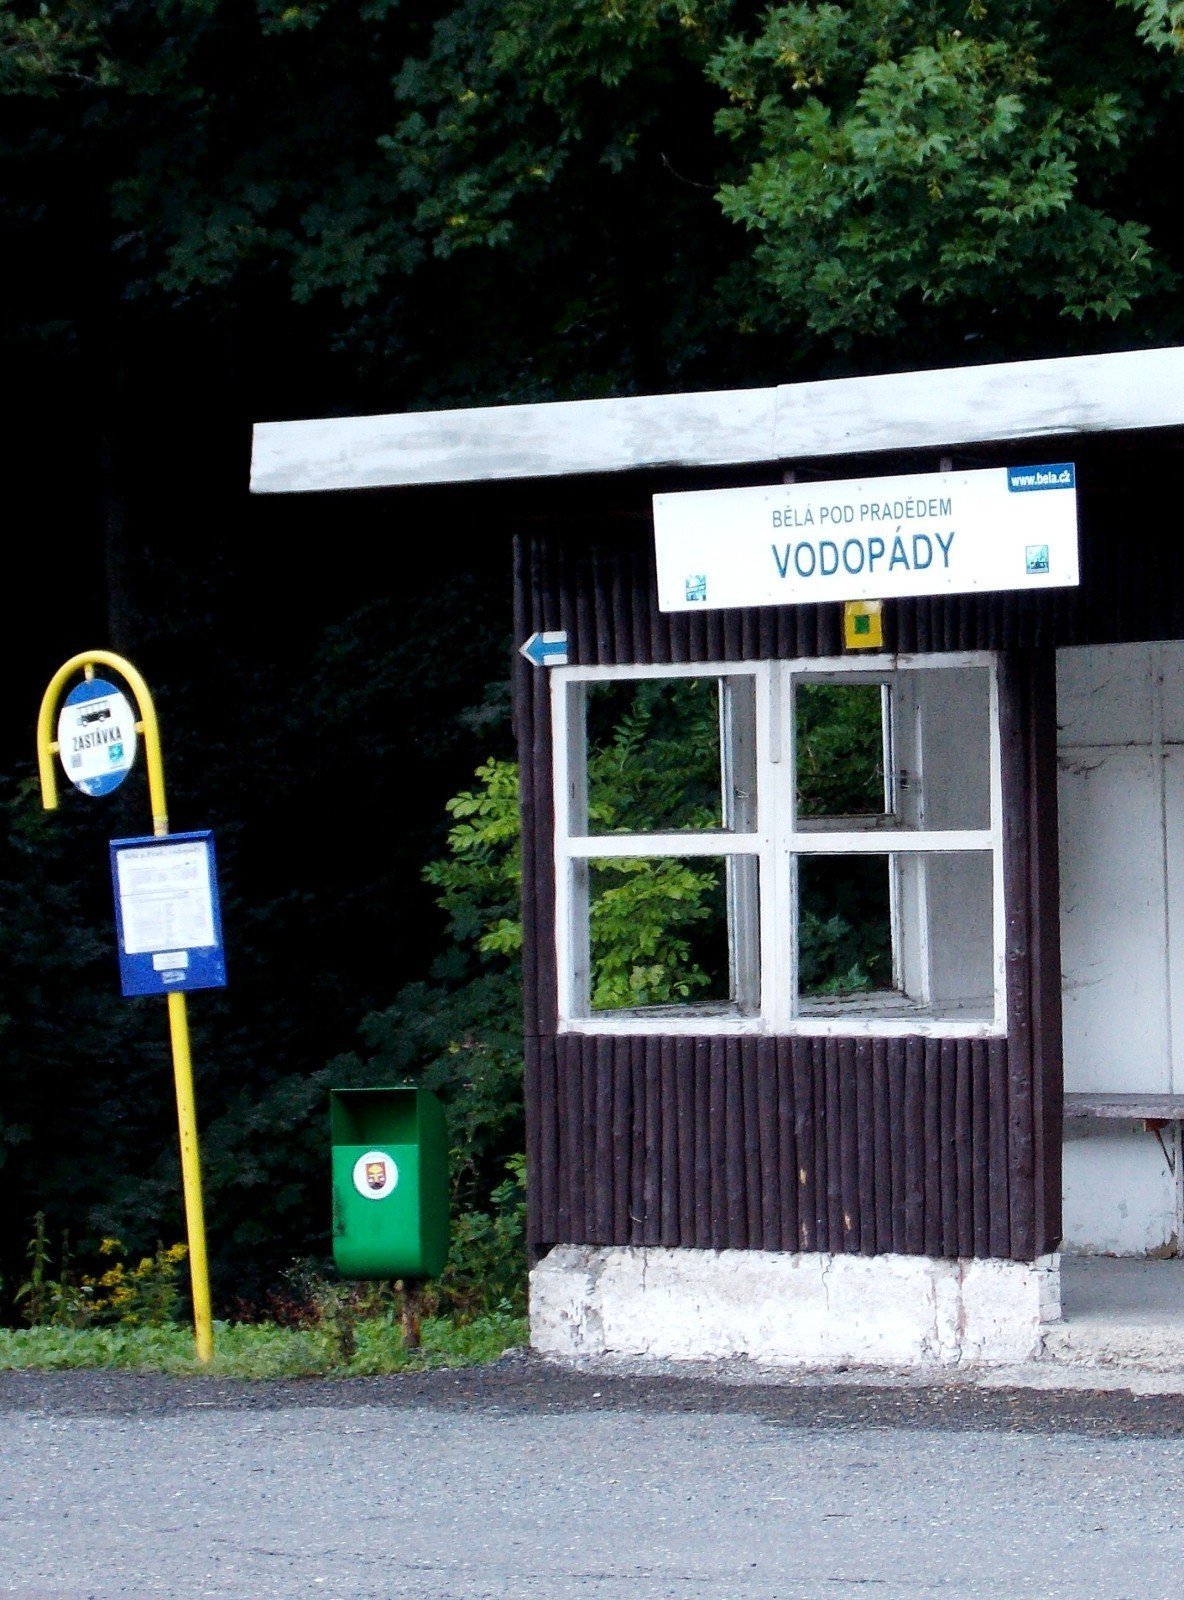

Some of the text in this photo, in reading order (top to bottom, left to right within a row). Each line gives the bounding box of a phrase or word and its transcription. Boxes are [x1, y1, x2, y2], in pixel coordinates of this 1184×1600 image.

[1011, 470, 1071, 487] www.bela.cz
[772, 496, 953, 528] BĚLÁ POD PRADĚDEM
[771, 525, 956, 579] VODOPÁDY
[72, 726, 123, 752] ZASTÁVKA
